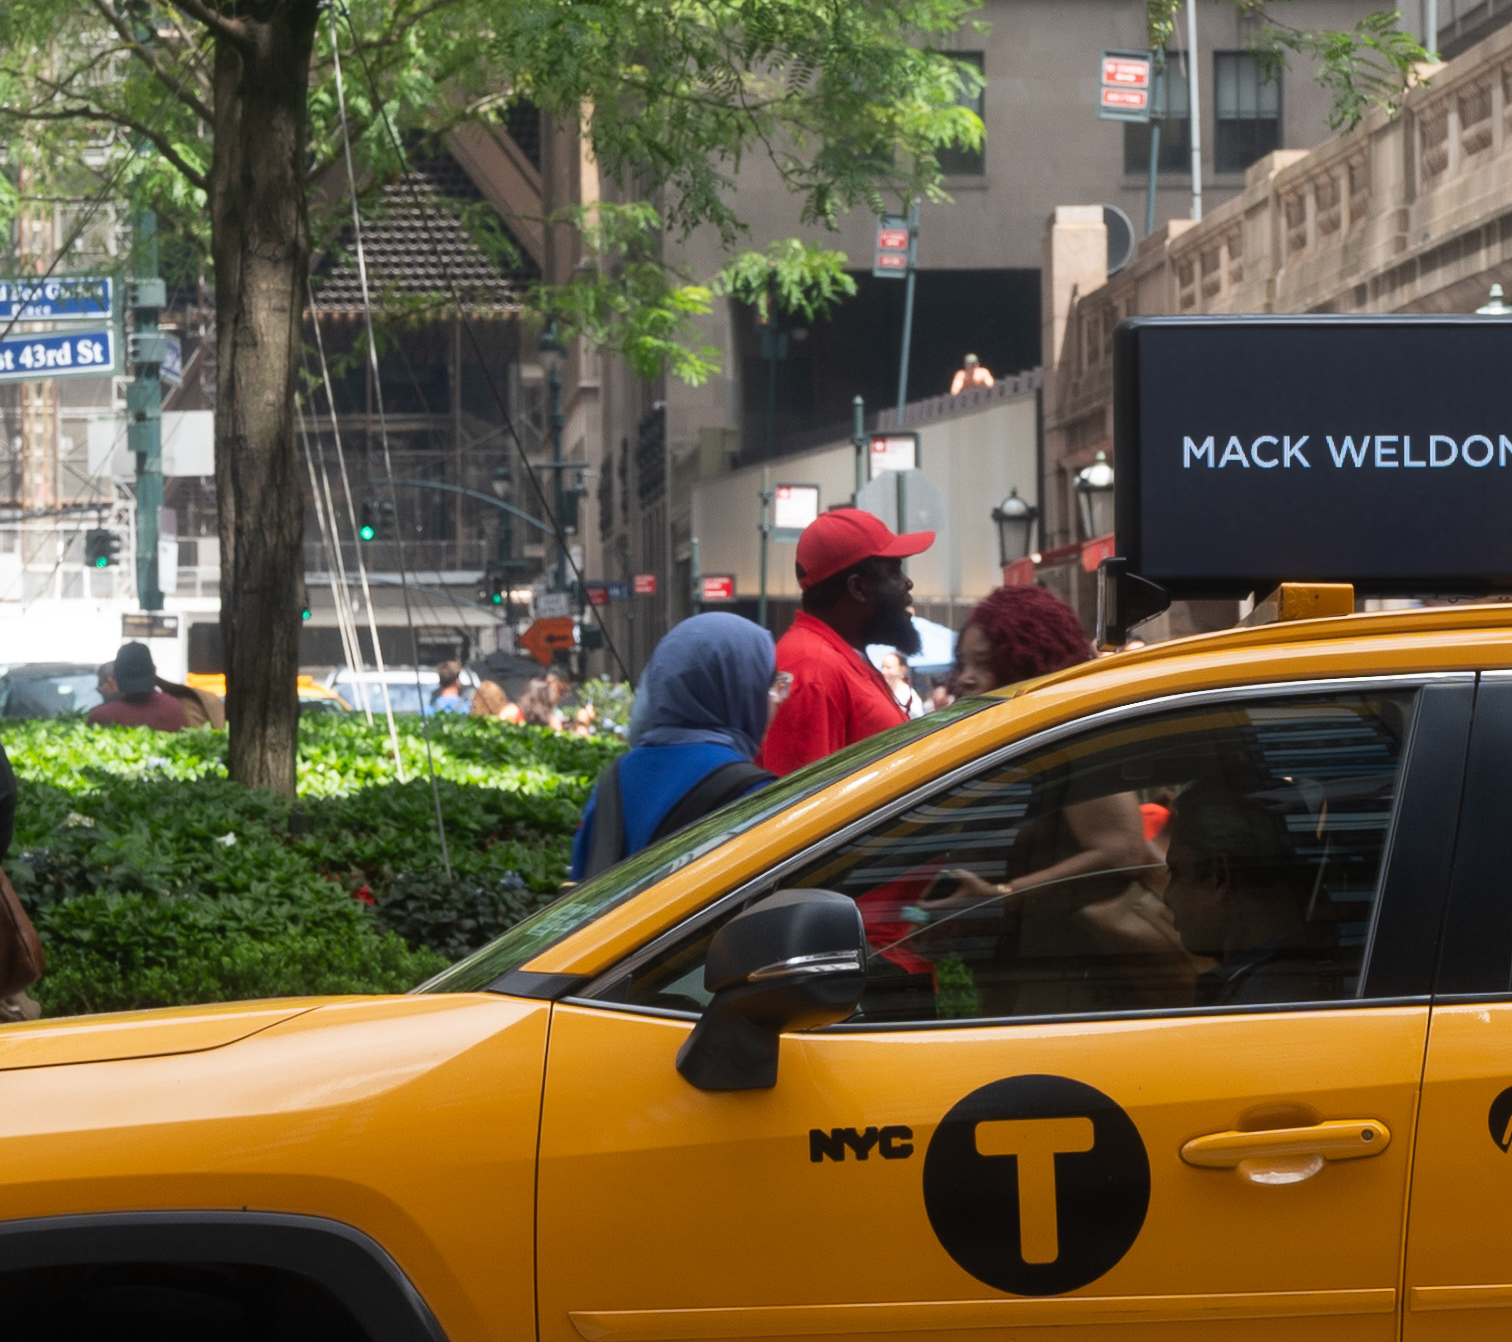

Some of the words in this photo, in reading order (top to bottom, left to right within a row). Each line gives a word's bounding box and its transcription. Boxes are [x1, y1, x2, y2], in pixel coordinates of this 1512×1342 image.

[18, 341, 72, 368] 43rd
[76, 339, 104, 363] St
[1182, 435, 1311, 469] MACK
[809, 1125, 915, 1163] NYC
[974, 1116, 1096, 1266] T
